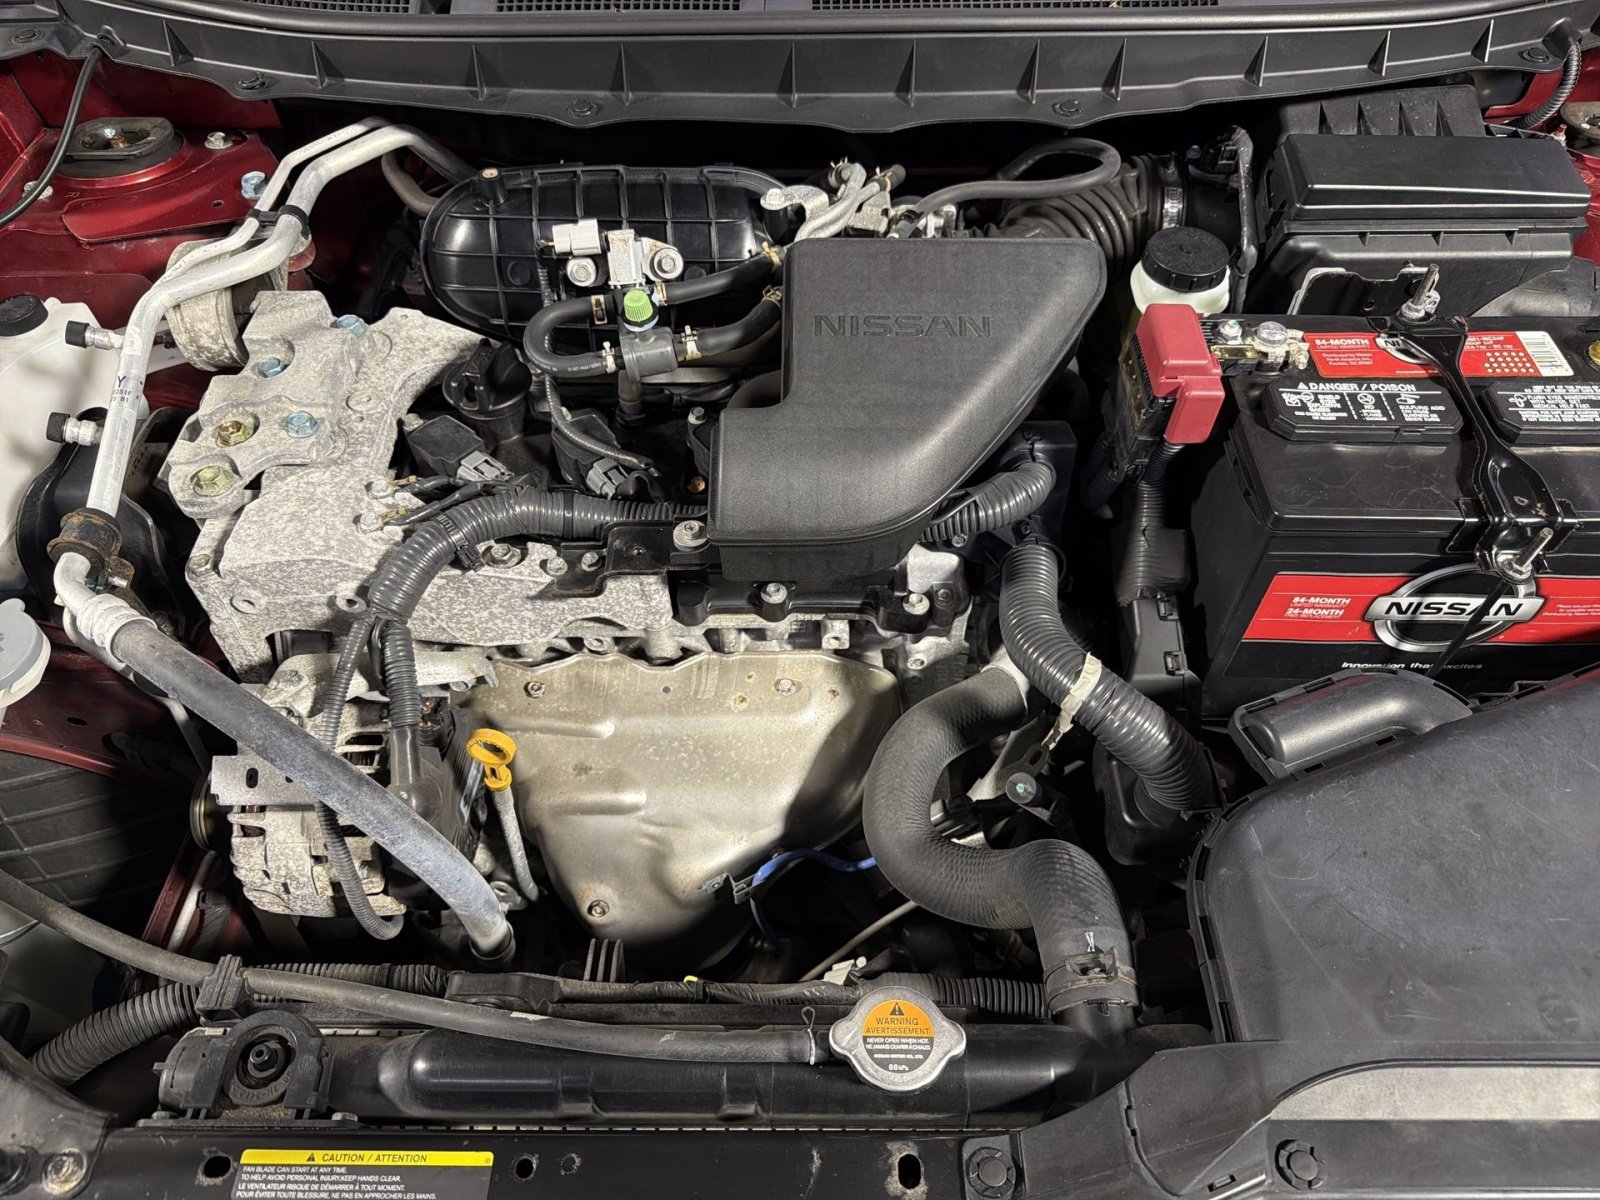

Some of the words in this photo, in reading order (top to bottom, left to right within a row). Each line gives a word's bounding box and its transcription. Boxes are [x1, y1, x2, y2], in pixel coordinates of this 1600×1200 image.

[814, 315, 990, 337] NISSAN
[1308, 383, 1359, 391] DANGER
[1361, 383, 1367, 391] /
[1286, 608, 1344, 616] 24-MONTH
[1384, 601, 1523, 616] NISSAN
[876, 1017, 918, 1025] WARNING
[321, 1153, 364, 1162] CAUTION
[366, 1153, 373, 1162] /
[374, 1154, 427, 1163] ATTENTION
[320, 1182, 355, 1191] DÉMARRER
[254, 1190, 276, 1198] ÉVITER
[276, 1191, 297, 1199] TOUTE
